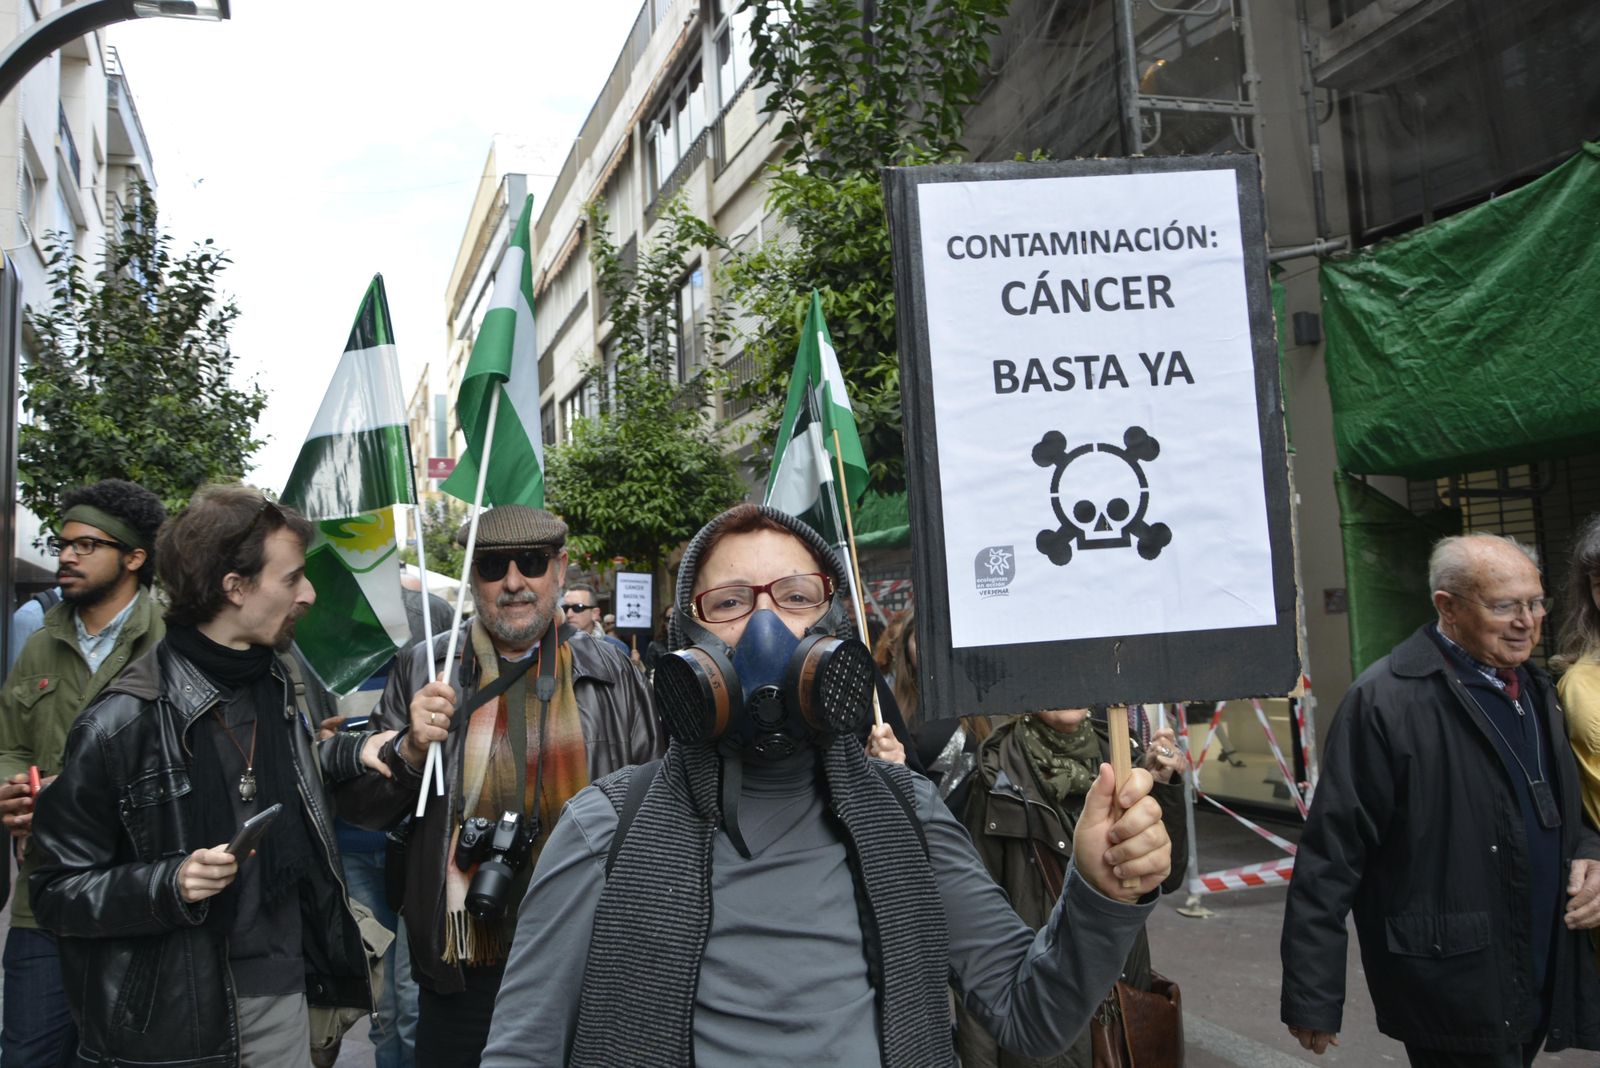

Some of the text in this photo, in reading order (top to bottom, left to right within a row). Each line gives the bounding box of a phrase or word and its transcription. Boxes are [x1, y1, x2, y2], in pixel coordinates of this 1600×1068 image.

[947, 219, 1218, 260] CONTAMINACIÓN:
[1001, 270, 1175, 316] CÁNCER
[992, 350, 1195, 395] BASTA YA
